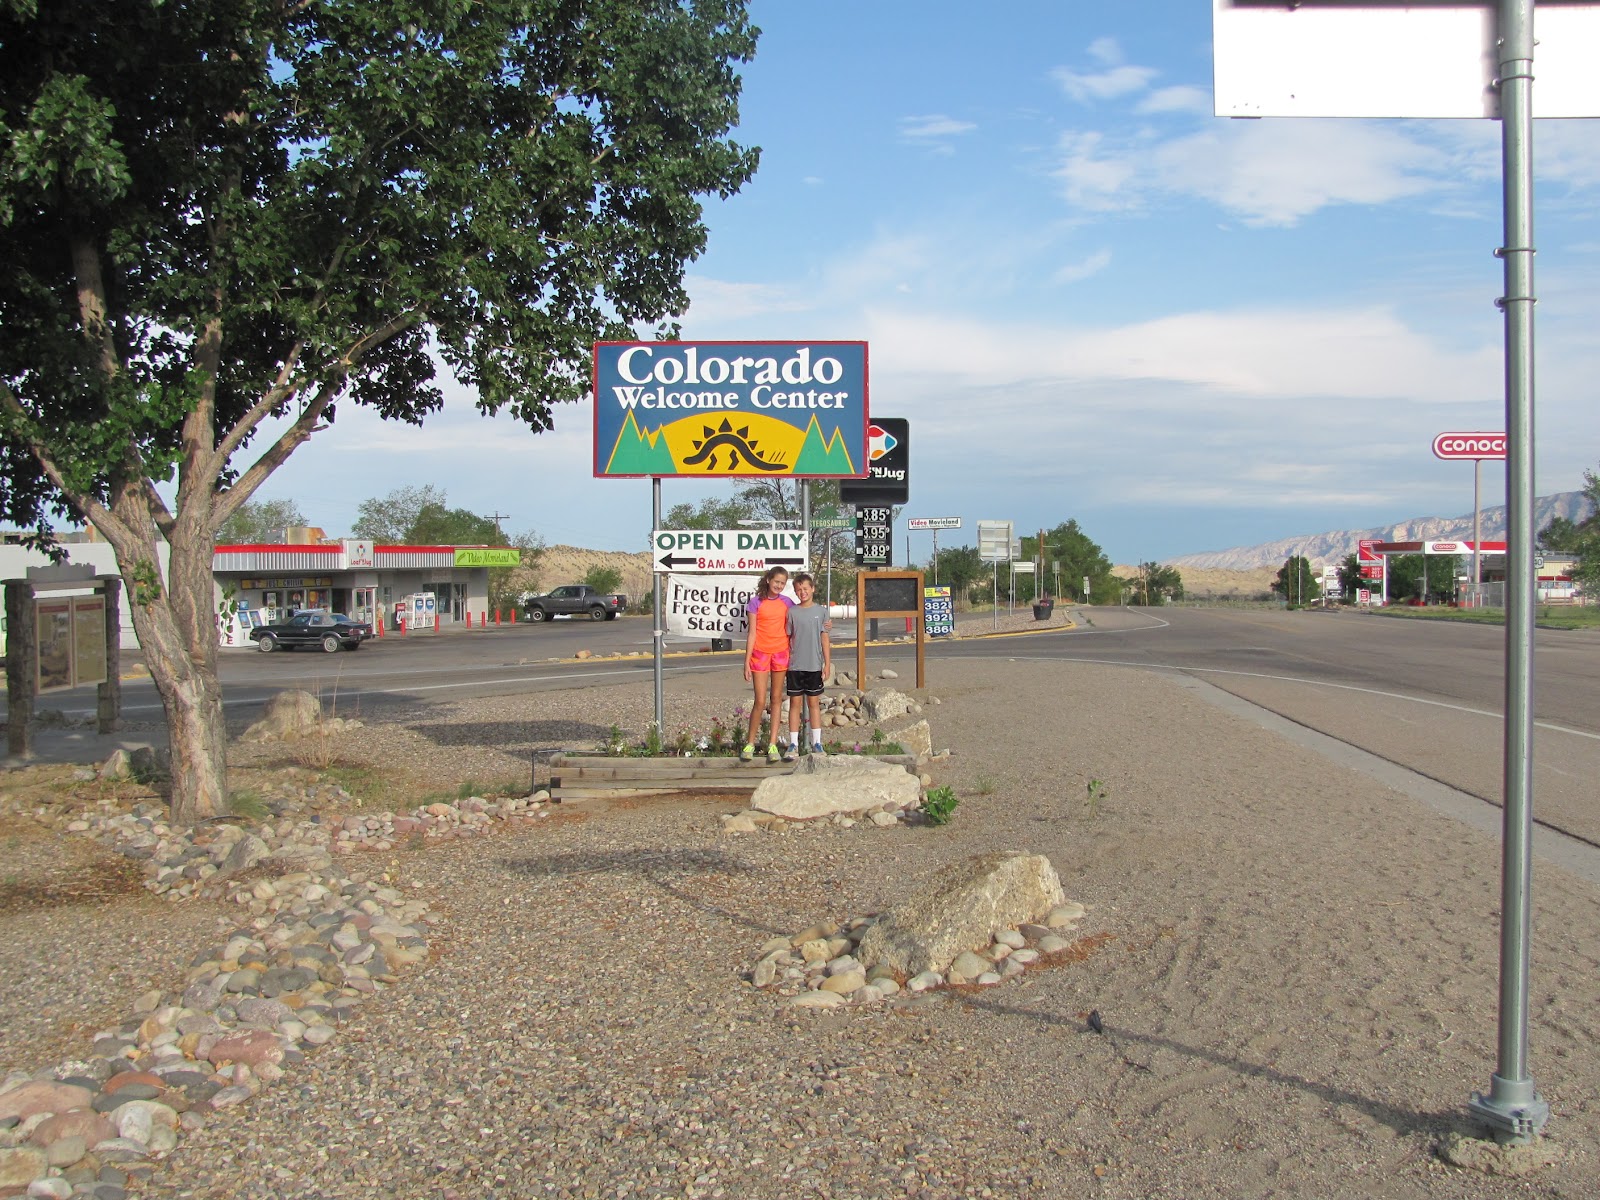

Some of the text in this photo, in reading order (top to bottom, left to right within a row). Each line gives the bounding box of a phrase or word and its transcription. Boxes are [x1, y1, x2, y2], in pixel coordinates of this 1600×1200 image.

[617, 346, 843, 384] Colorado
[612, 385, 848, 410] Welcome Center
[809, 519, 850, 528] STEGOSAURUS
[656, 533, 804, 550] OPEN DAILY
[467, 552, 482, 562] Video
[674, 584, 709, 603] Free
[673, 602, 748, 618] Free Col
[687, 617, 734, 632] State
